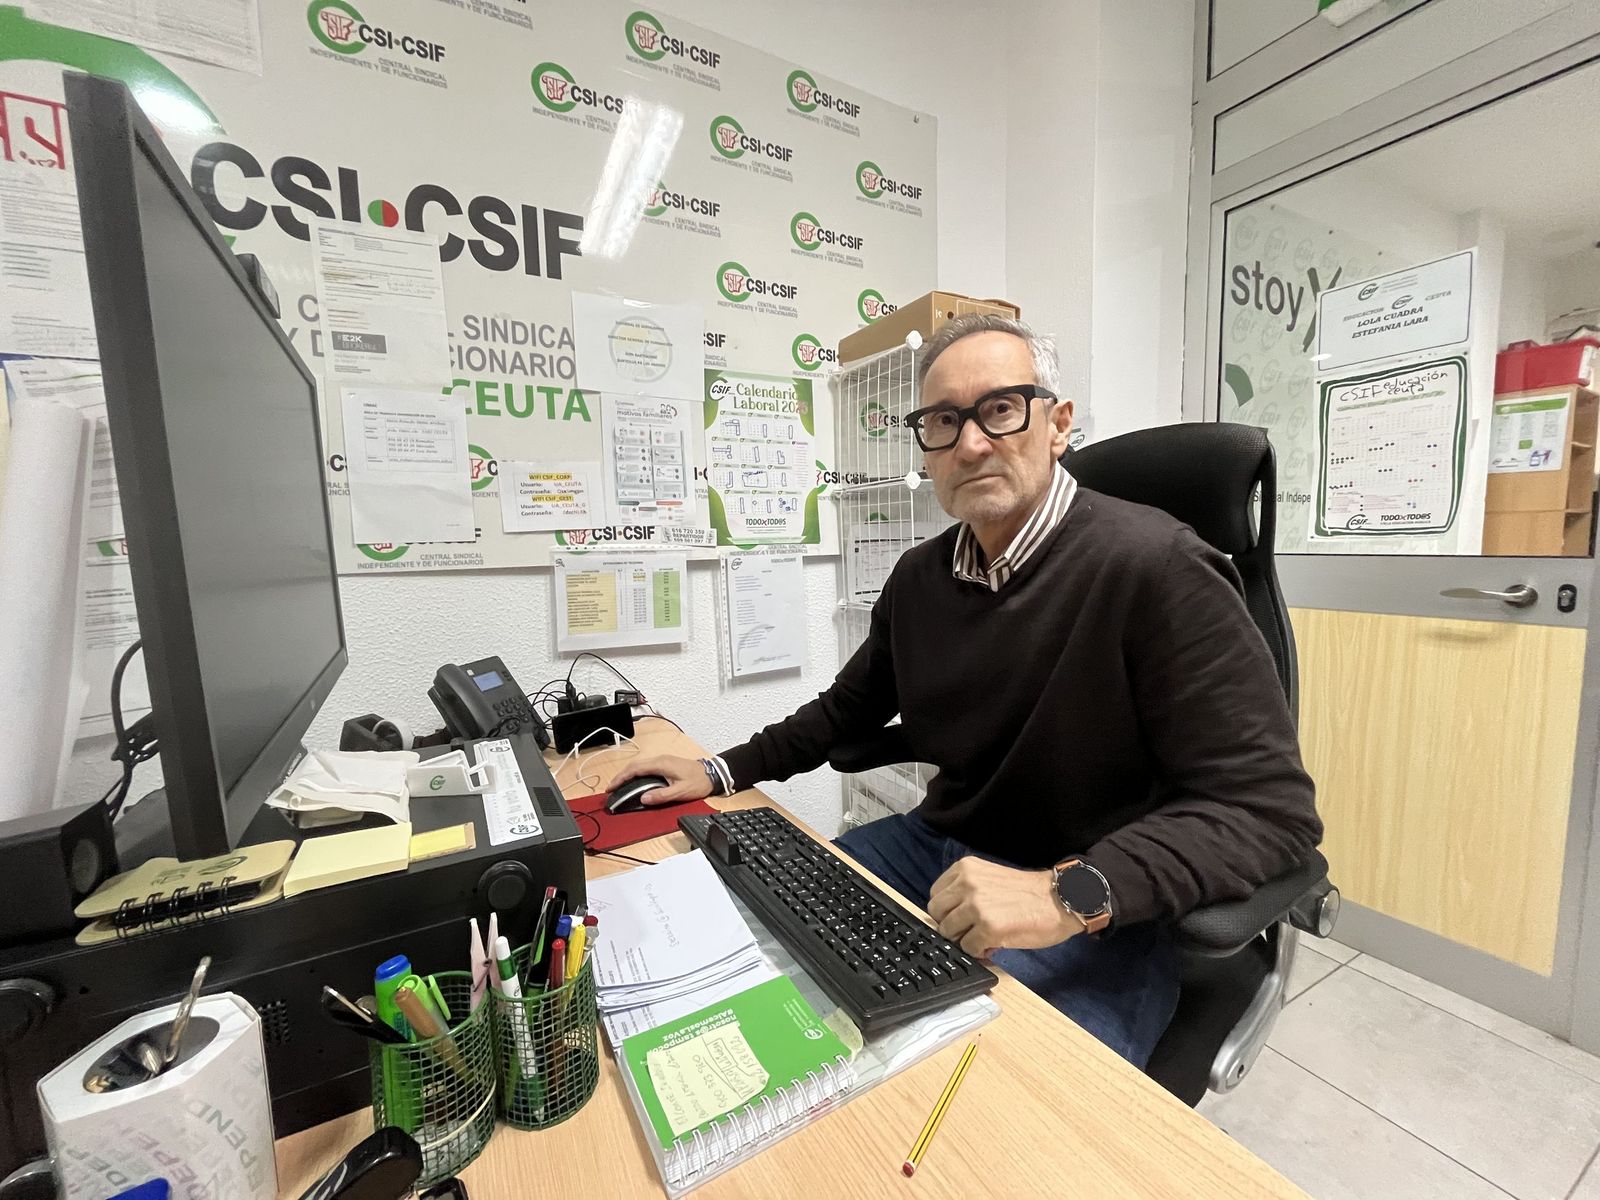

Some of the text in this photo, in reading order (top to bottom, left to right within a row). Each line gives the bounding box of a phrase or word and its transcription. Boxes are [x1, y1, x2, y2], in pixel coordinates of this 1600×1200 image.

[503, 8, 532, 21] SINDICAL
[308, 46, 372, 70] INDEPENDIENTE
[381, 65, 392, 75] DE
[393, 67, 448, 89] FUNCIONARIOS
[379, 57, 447, 82] CENTRAL SINDICAL
[673, 63, 696, 77] CENTRAL
[532, 106, 580, 126] INDEPENDIENTE
[585, 114, 613, 128] CENTRAL
[675, 217, 697, 226] CENTRAL
[757, 301, 777, 310] CENTRAL
[1357, 306, 1424, 328] LOLA CUADRA
[1403, 315, 1429, 328] LARA
[463, 314, 575, 350] SINDICA
[1340, 384, 1382, 401] CSIF
[733, 396, 779, 412] Laboral
[357, 561, 414, 570] INDEPENDIENTE
[433, 558, 484, 567] FUNCIONARIOS
